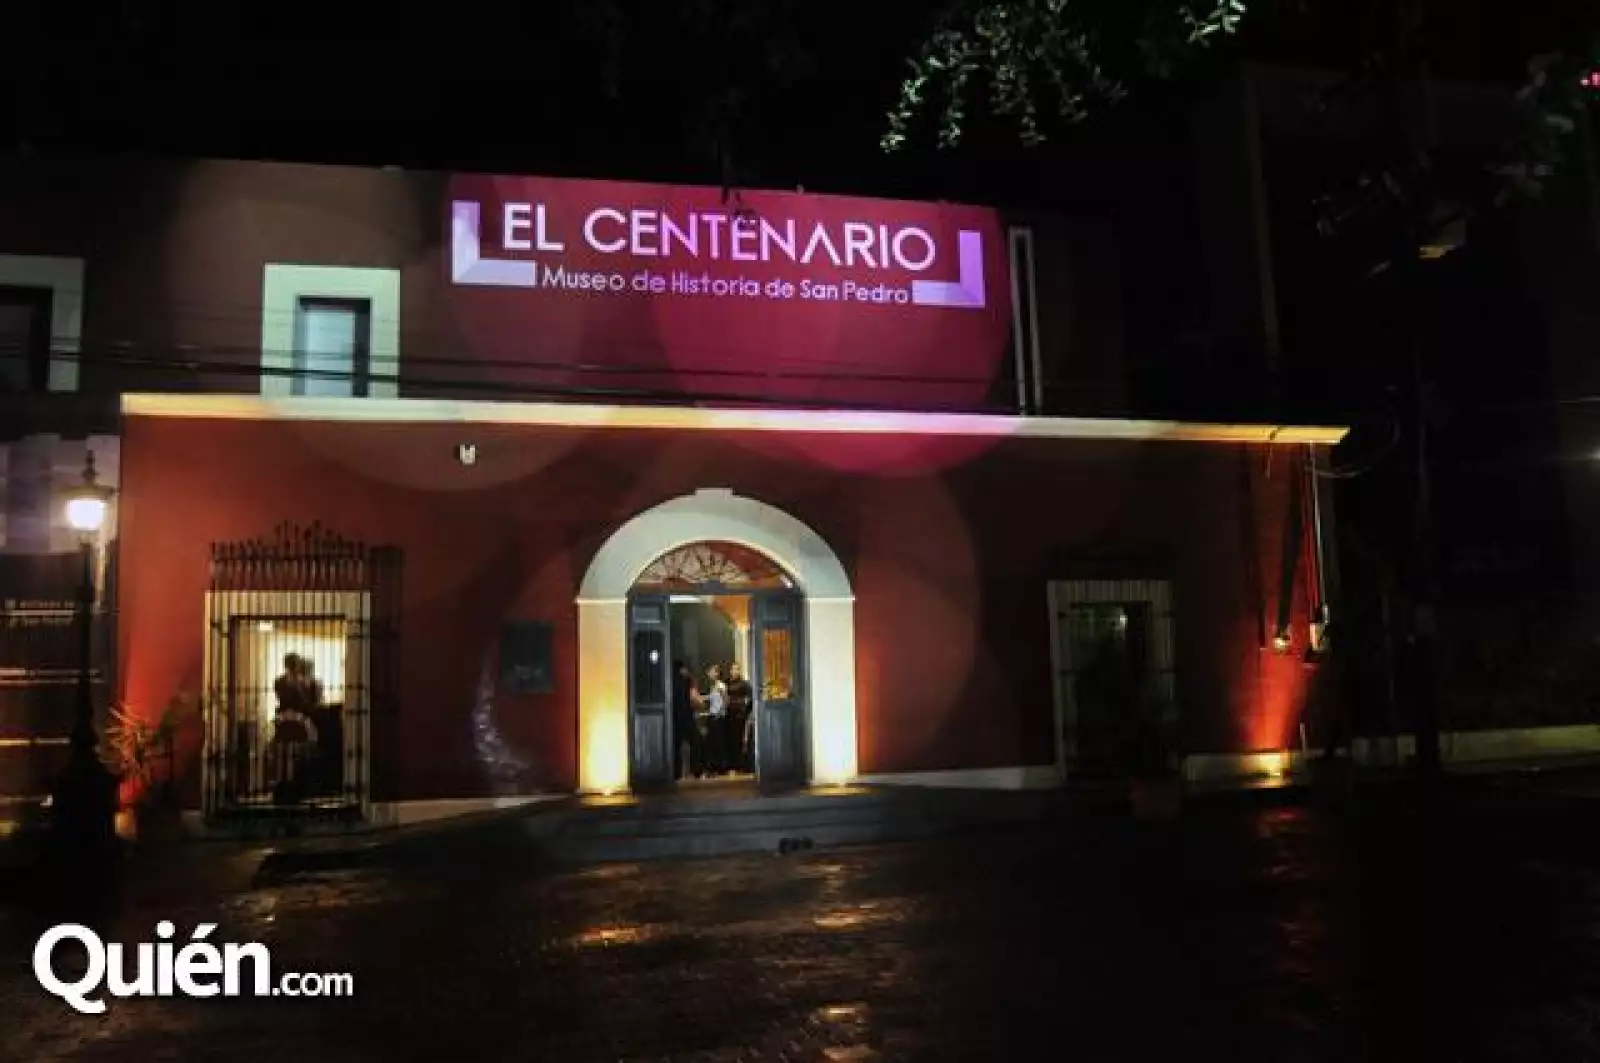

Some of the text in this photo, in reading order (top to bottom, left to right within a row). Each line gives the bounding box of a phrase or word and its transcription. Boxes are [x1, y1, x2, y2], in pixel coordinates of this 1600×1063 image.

[503, 203, 936, 270] EL CENTENARIO
[542, 264, 909, 304] Museo de Historia de San Pedro
